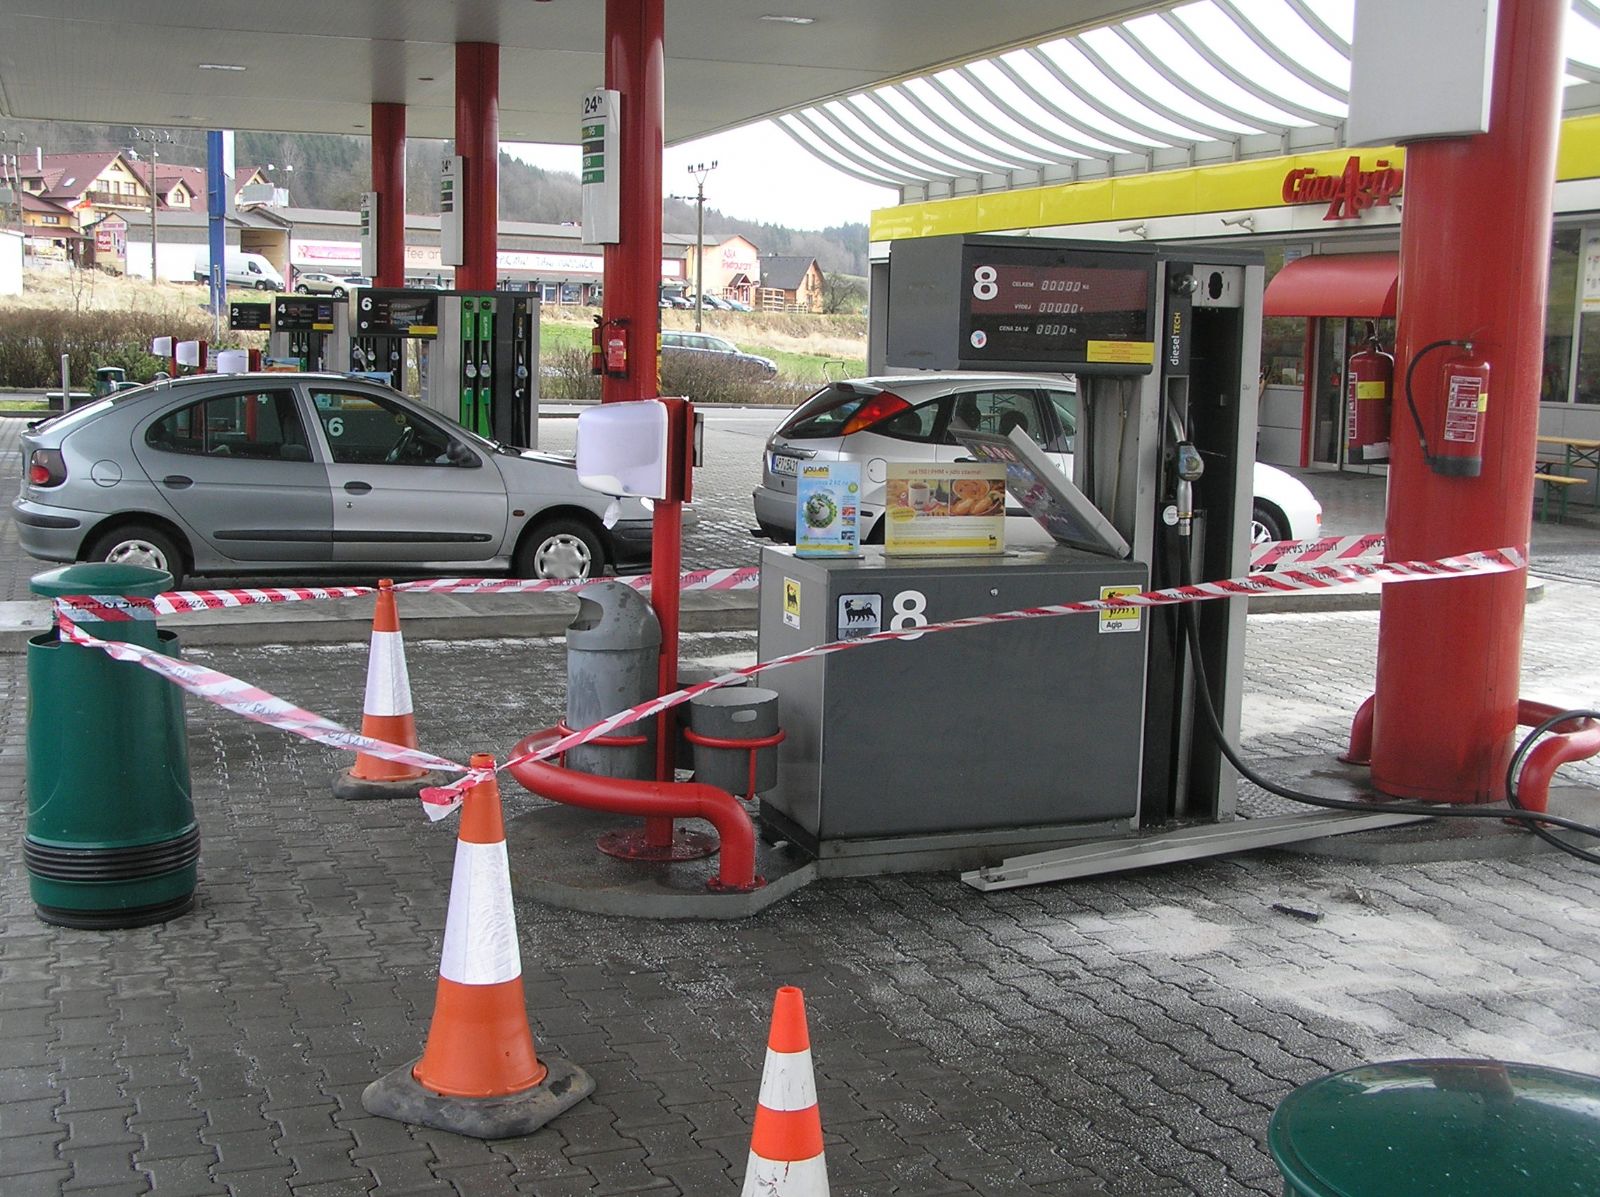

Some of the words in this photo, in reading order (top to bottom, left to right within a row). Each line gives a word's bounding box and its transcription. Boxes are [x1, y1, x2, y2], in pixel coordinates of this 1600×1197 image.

[406, 246, 424, 259] fee
[973, 265, 999, 300] 8
[232, 308, 240, 316] 2
[277, 303, 287, 315] 4
[361, 297, 373, 311] 6
[1173, 312, 1182, 335] TECH
[1170, 335, 1180, 366] diesel
[328, 417, 344, 437] 6
[890, 589, 928, 641] 8
[1106, 621, 1123, 629] Agip
